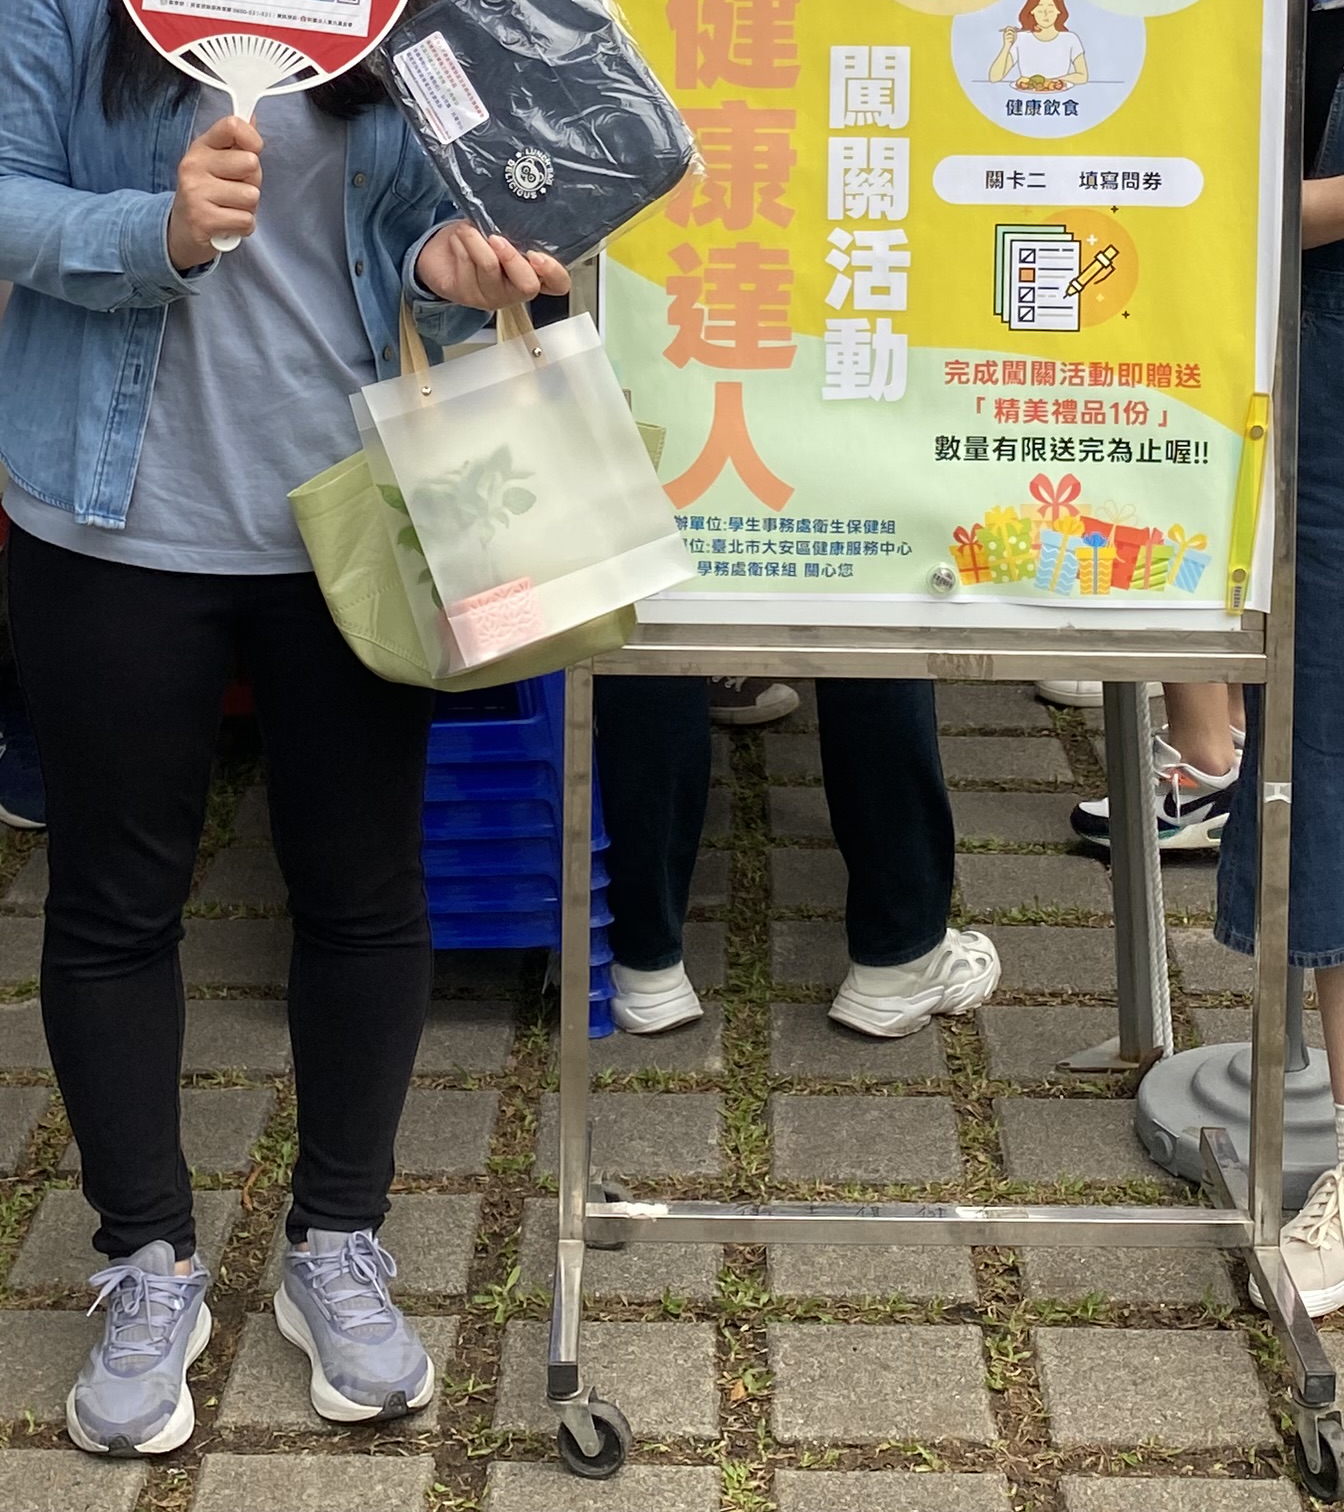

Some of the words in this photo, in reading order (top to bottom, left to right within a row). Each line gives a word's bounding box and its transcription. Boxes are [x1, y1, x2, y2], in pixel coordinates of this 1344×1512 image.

[1005, 97, 1080, 118] 健康飲食
[985, 169, 1047, 191] 關卡二
[822, 45, 912, 402] 闖關活動
[943, 359, 1203, 389] 完成闖關活動即贈送
[933, 434, 1210, 466] 數量有限送完為止喔!!
[684, 538, 913, 556] 位:臺北市大安區健康服務中心
[697, 560, 797, 578] 學務處衛保組
[804, 562, 854, 578] 關心您
